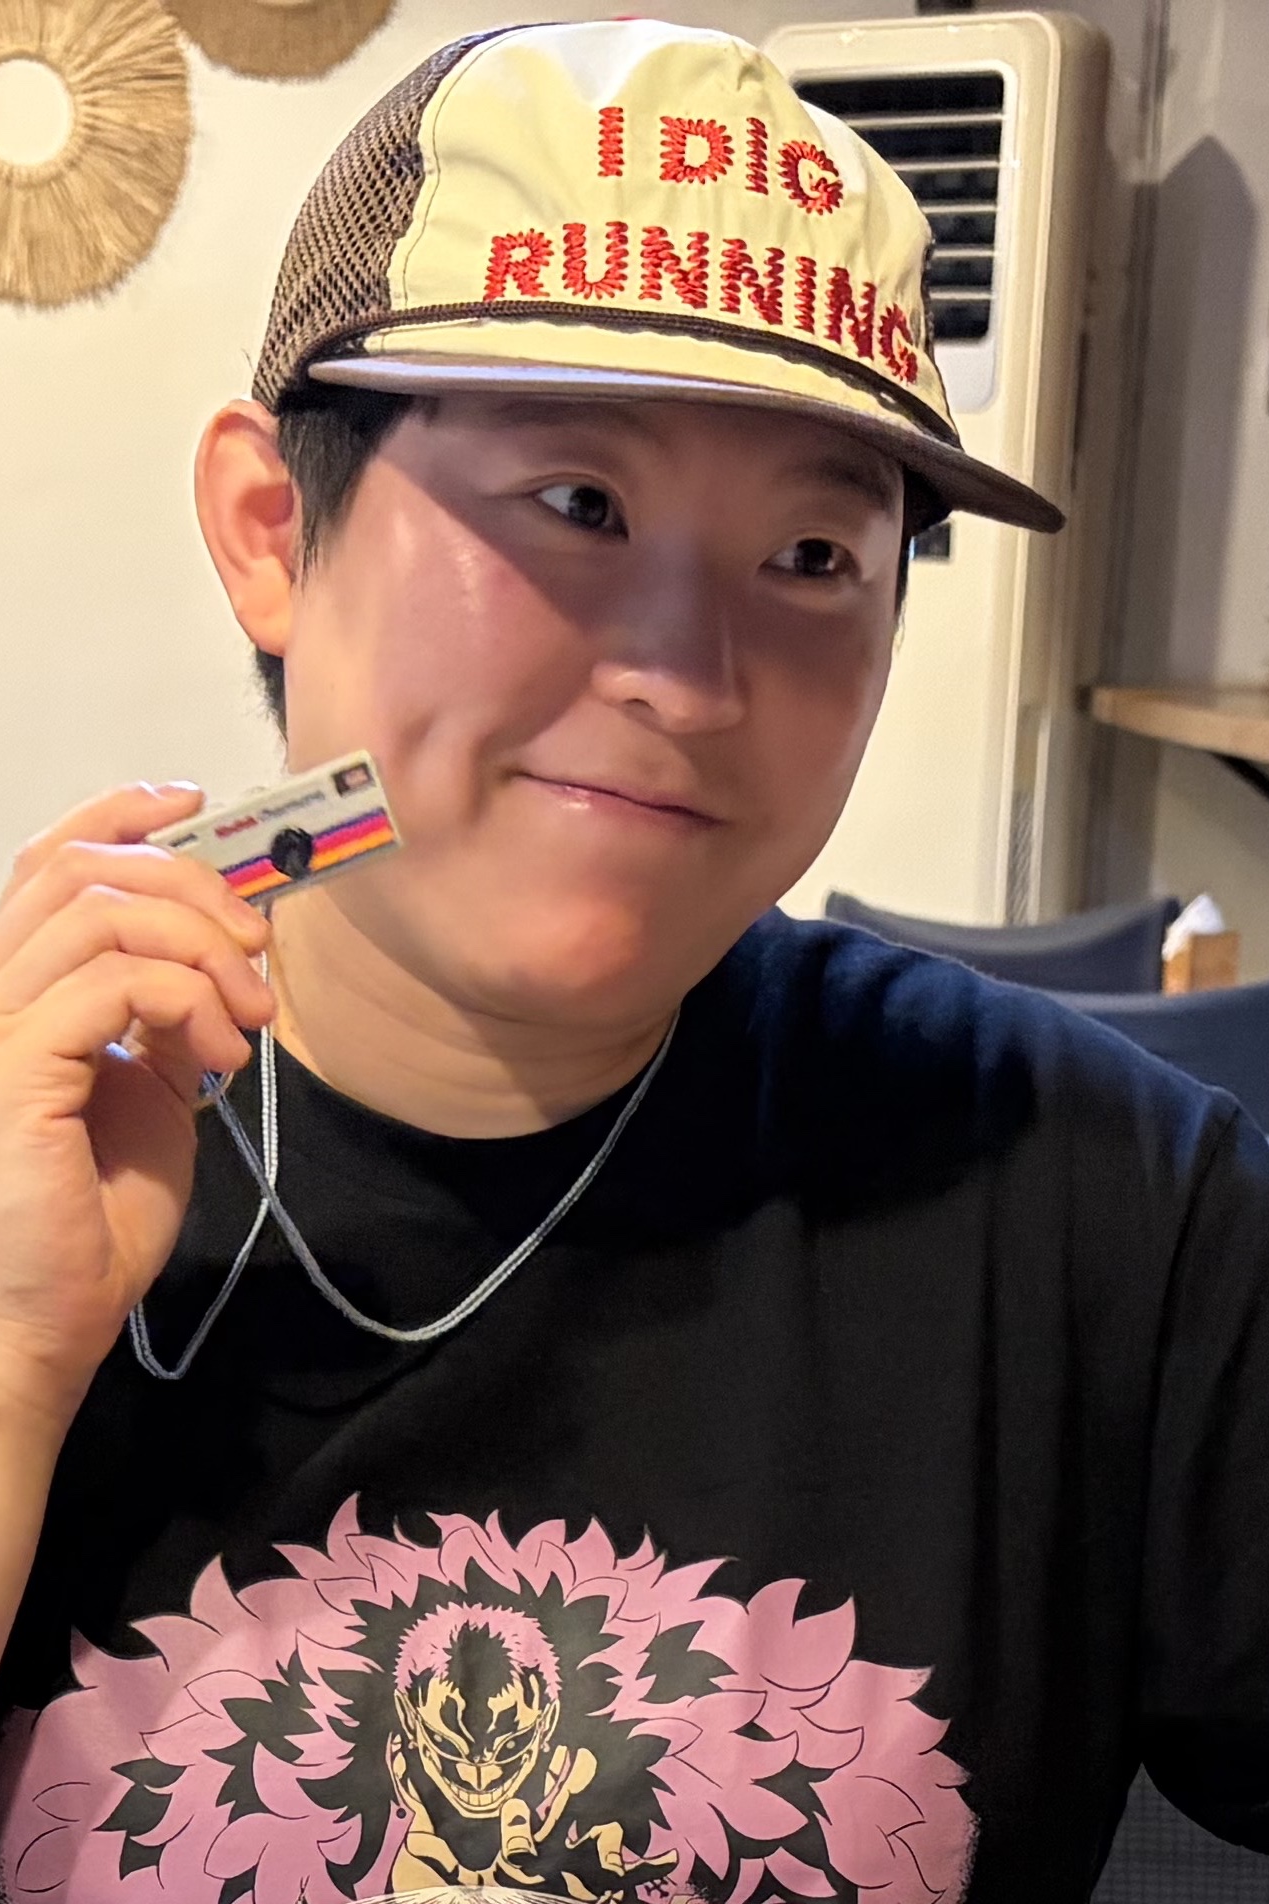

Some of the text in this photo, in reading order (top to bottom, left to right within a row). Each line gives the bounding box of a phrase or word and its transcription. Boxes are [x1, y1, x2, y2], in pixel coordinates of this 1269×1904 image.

[598, 106, 844, 216] I DIG
[483, 221, 918, 384] RUNNING
